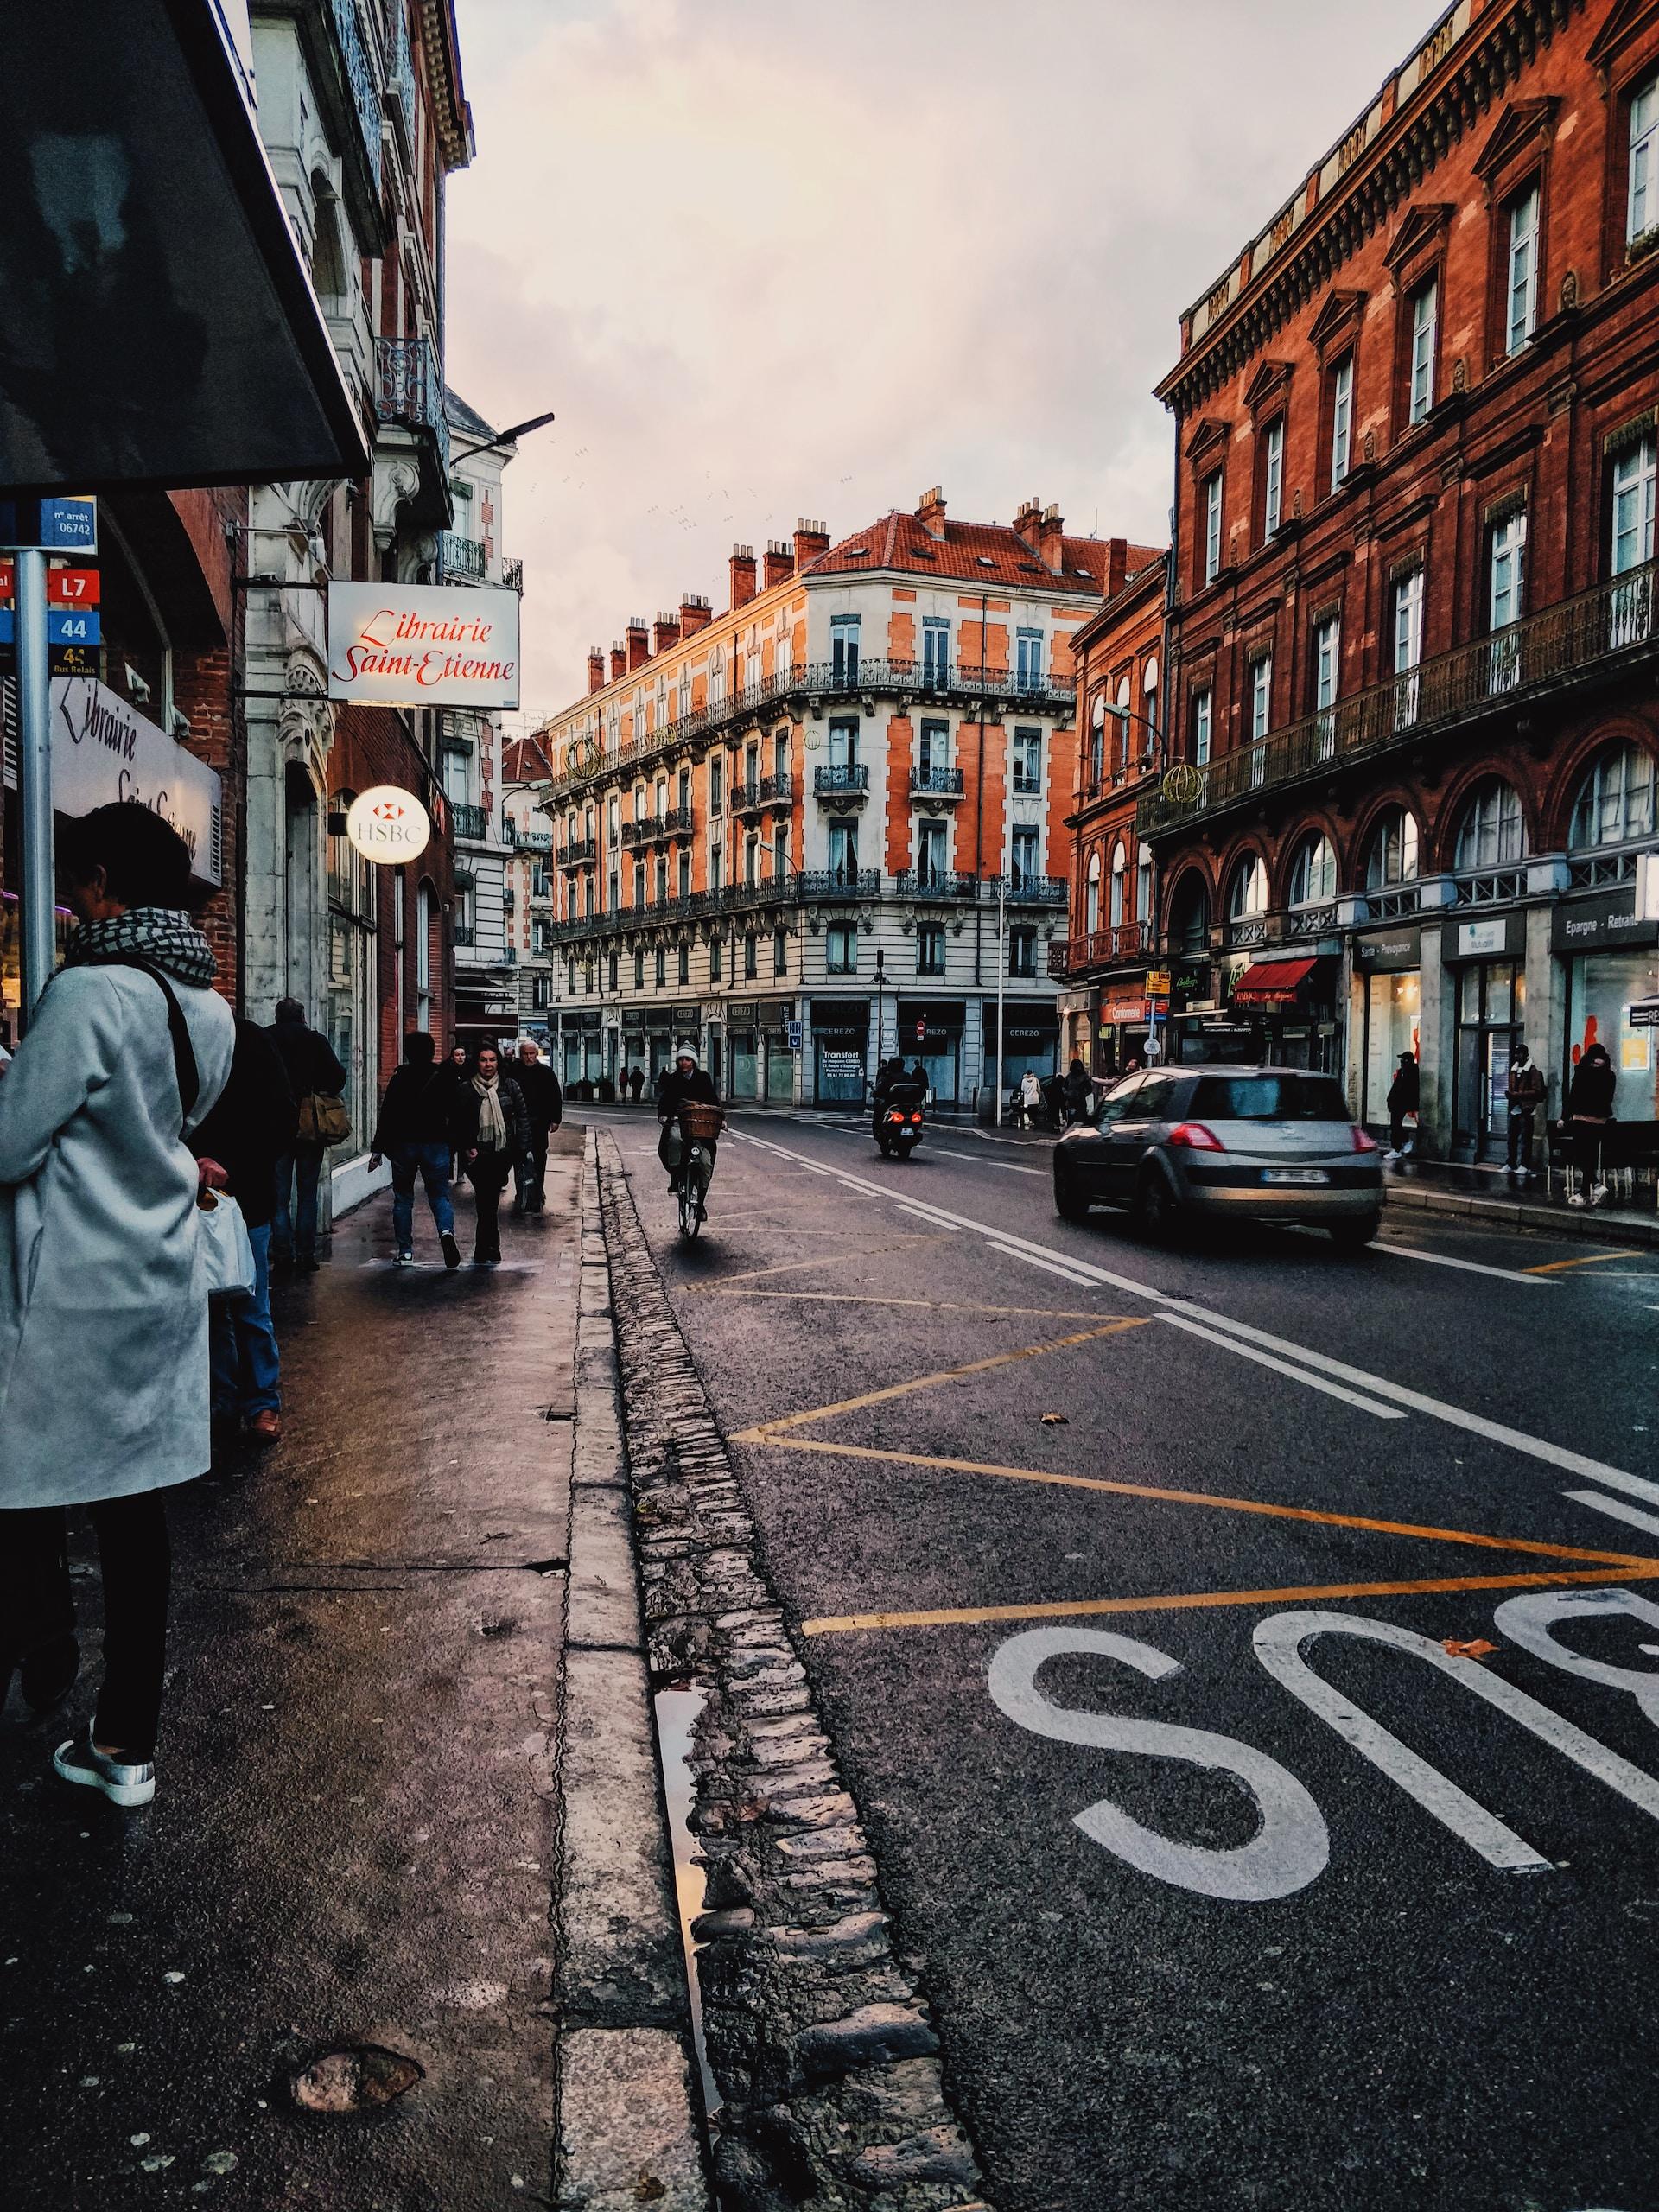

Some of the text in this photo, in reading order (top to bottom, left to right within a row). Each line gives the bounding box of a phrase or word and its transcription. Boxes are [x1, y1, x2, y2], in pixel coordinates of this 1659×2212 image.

[67, 511, 89, 522] arrêt
[60, 522, 91, 535] 06742
[62, 578, 86, 597] L7
[60, 620, 87, 638] 44
[359, 609, 493, 647] Librairie
[54, 664, 96, 675] Bus Relais
[331, 645, 516, 686] Saint-Etienne
[357, 822, 422, 844] HSBC
[1566, 918, 1598, 937] Epargne
[731, 1006, 751, 1016] CEREZO
[823, 1051, 859, 1059] Transfert
